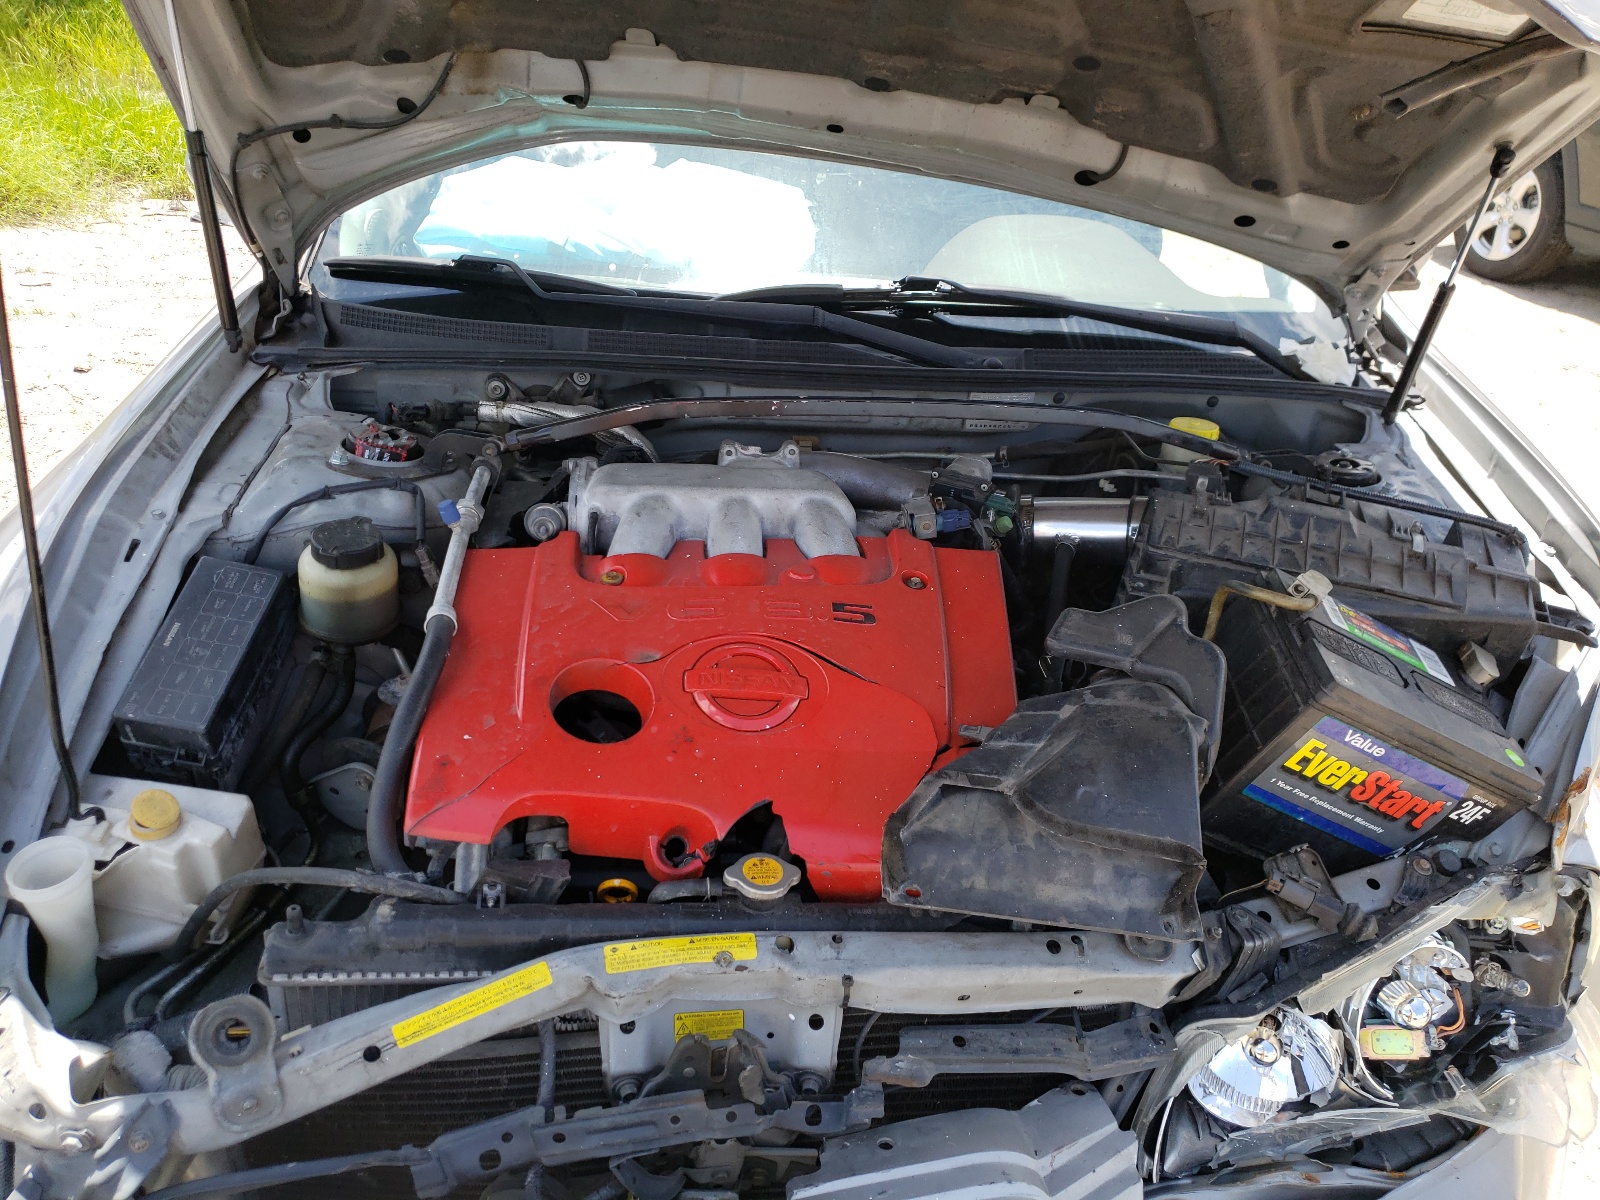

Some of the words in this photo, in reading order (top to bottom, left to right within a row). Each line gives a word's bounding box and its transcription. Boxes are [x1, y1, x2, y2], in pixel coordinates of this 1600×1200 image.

[162, 622, 180, 647] NISSAN
[697, 671, 797, 688] NISSAN
[1343, 729, 1387, 758] Value
[1283, 738, 1450, 830] EverStart
[1276, 779, 1292, 791] Year
[1292, 788, 1310, 799] Free
[1308, 795, 1355, 820] Replacement
[1353, 816, 1385, 834] Warranty
[1449, 800, 1492, 825] 24F
